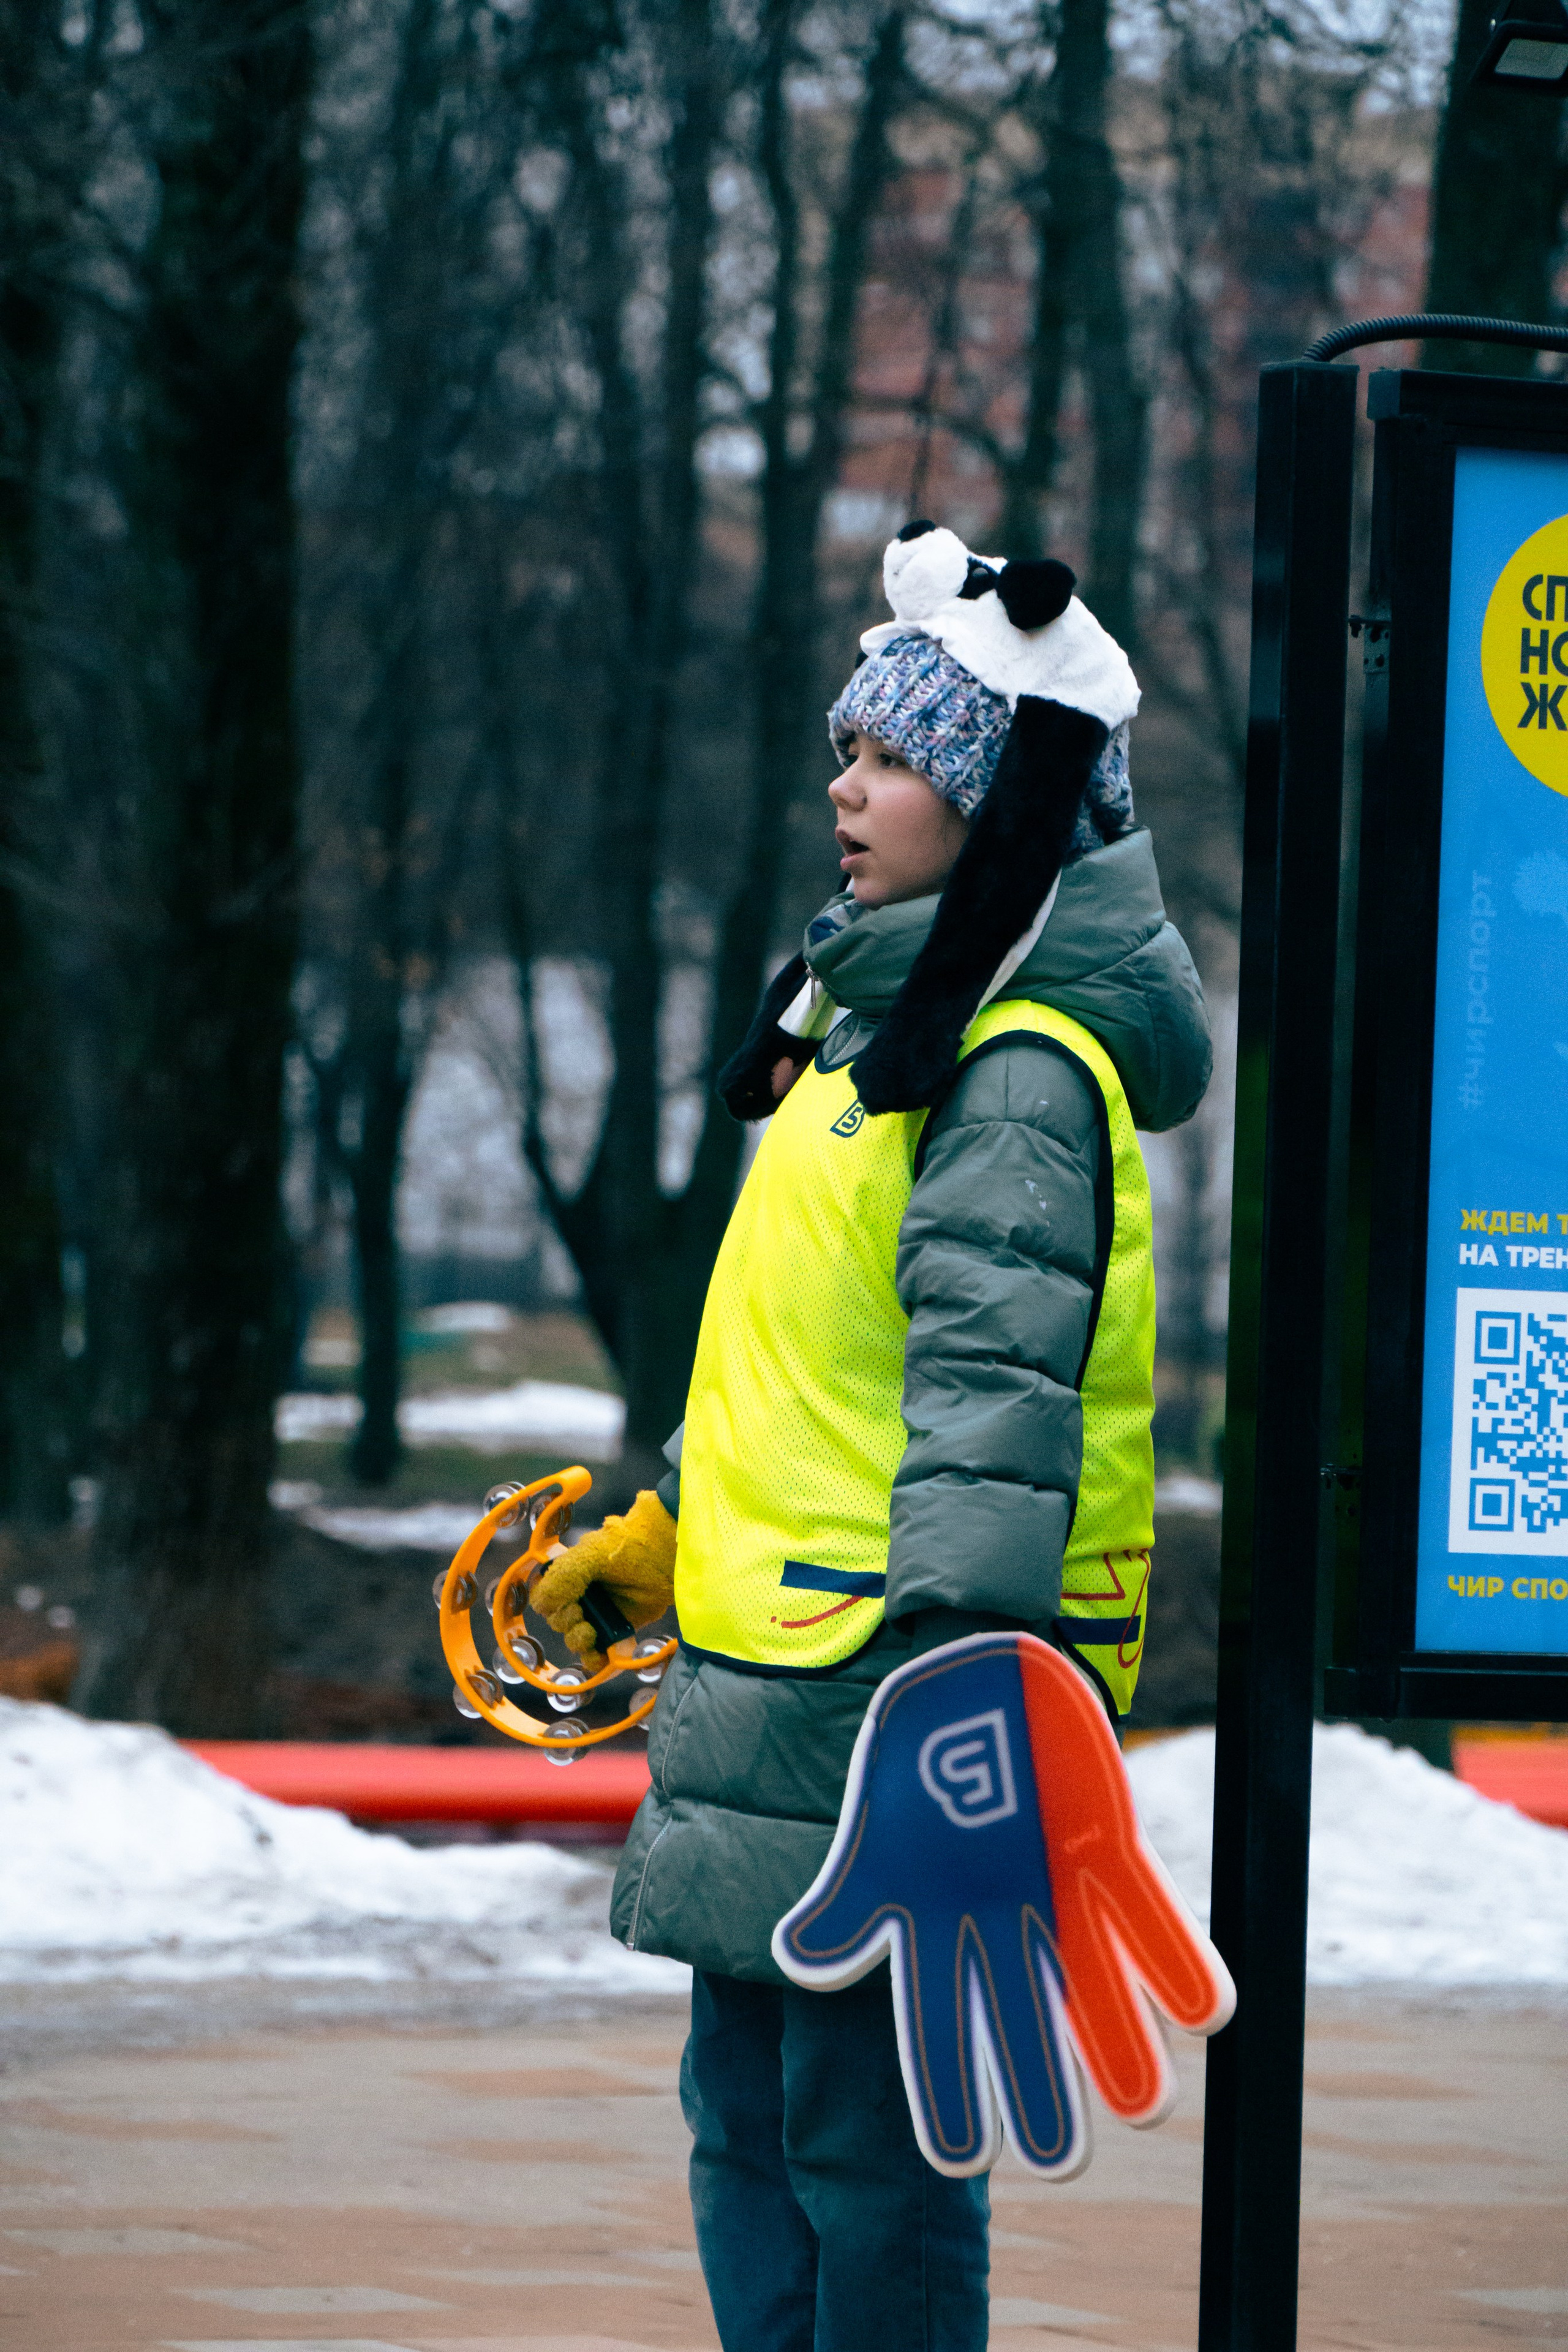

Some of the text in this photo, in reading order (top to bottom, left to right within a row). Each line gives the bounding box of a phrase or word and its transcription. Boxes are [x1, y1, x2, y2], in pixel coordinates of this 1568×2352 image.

[1517, 682, 1568, 731] Ж
[1458, 869, 1497, 1110] #чирспорт
[1460, 1208, 1548, 1236] ЖДЕМ
[1459, 1243, 1568, 1269] НА ТРЕН
[1447, 1575, 1568, 1600] ЧИР СПО
